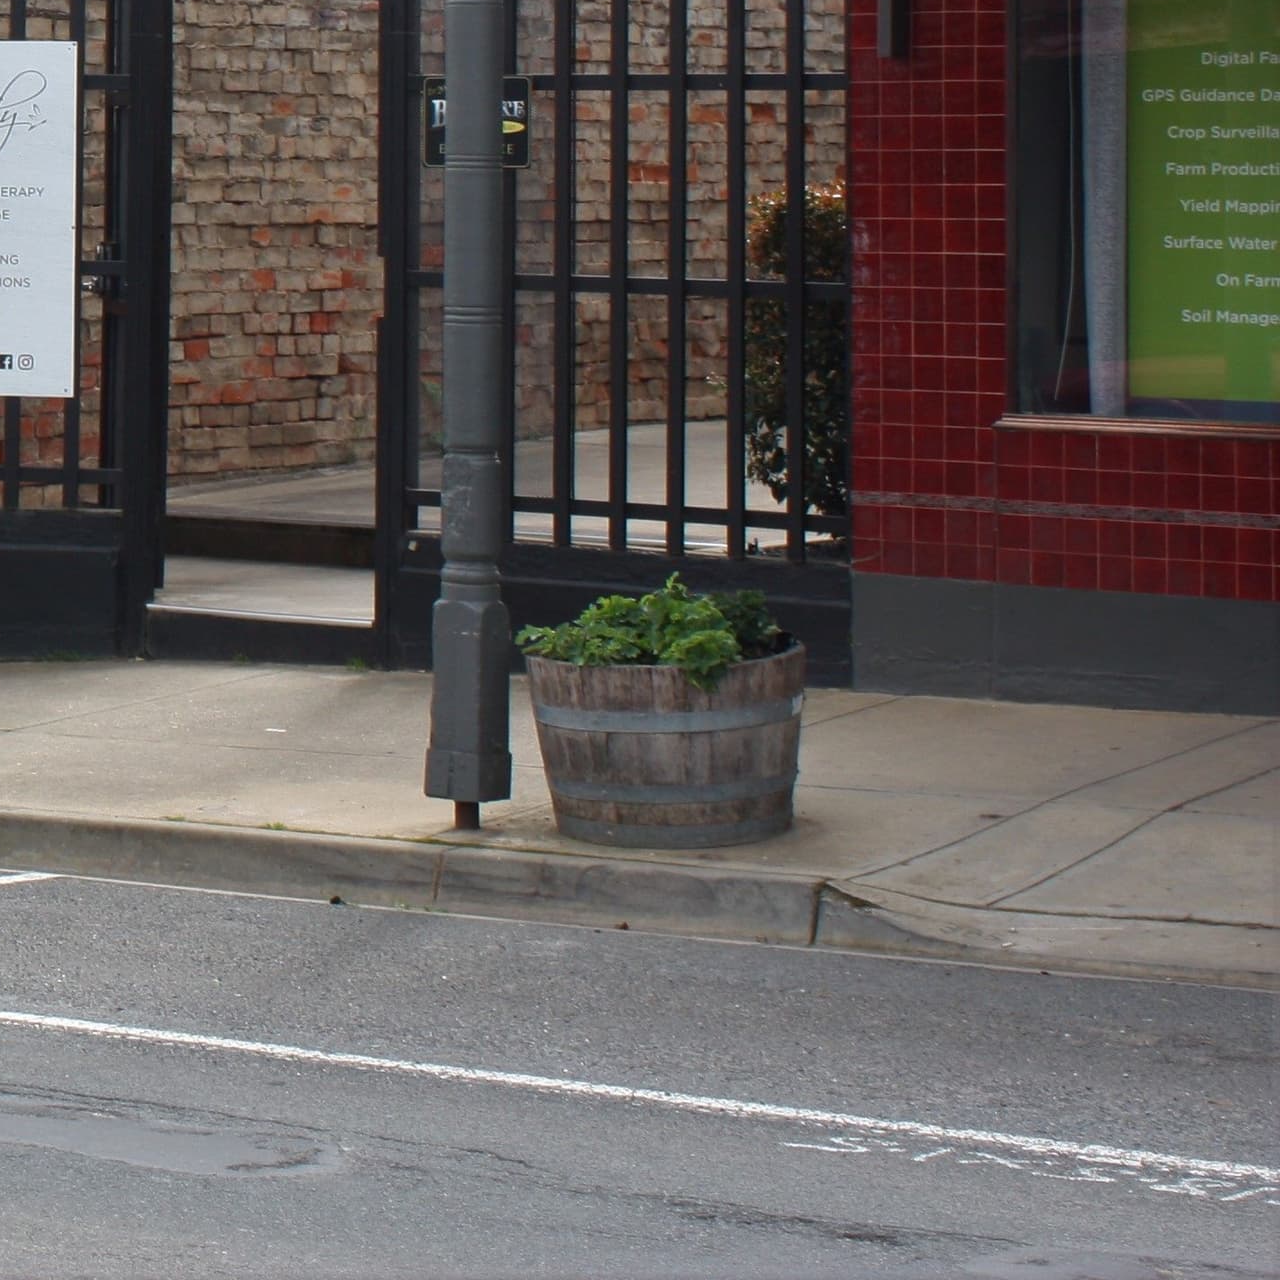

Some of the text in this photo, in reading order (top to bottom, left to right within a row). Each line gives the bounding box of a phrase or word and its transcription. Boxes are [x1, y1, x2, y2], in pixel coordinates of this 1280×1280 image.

[1201, 51, 1254, 67] Digital
[1141, 89, 1175, 102] GPS
[1180, 88, 1255, 102] Guidance
[1167, 126, 1206, 140] Crop
[1165, 162, 1206, 175] Farm
[1180, 199, 1220, 212] Yield
[1163, 235, 1278, 250] Surface Water
[1216, 273, 1240, 287] On
[1181, 309, 1211, 323] Soil
